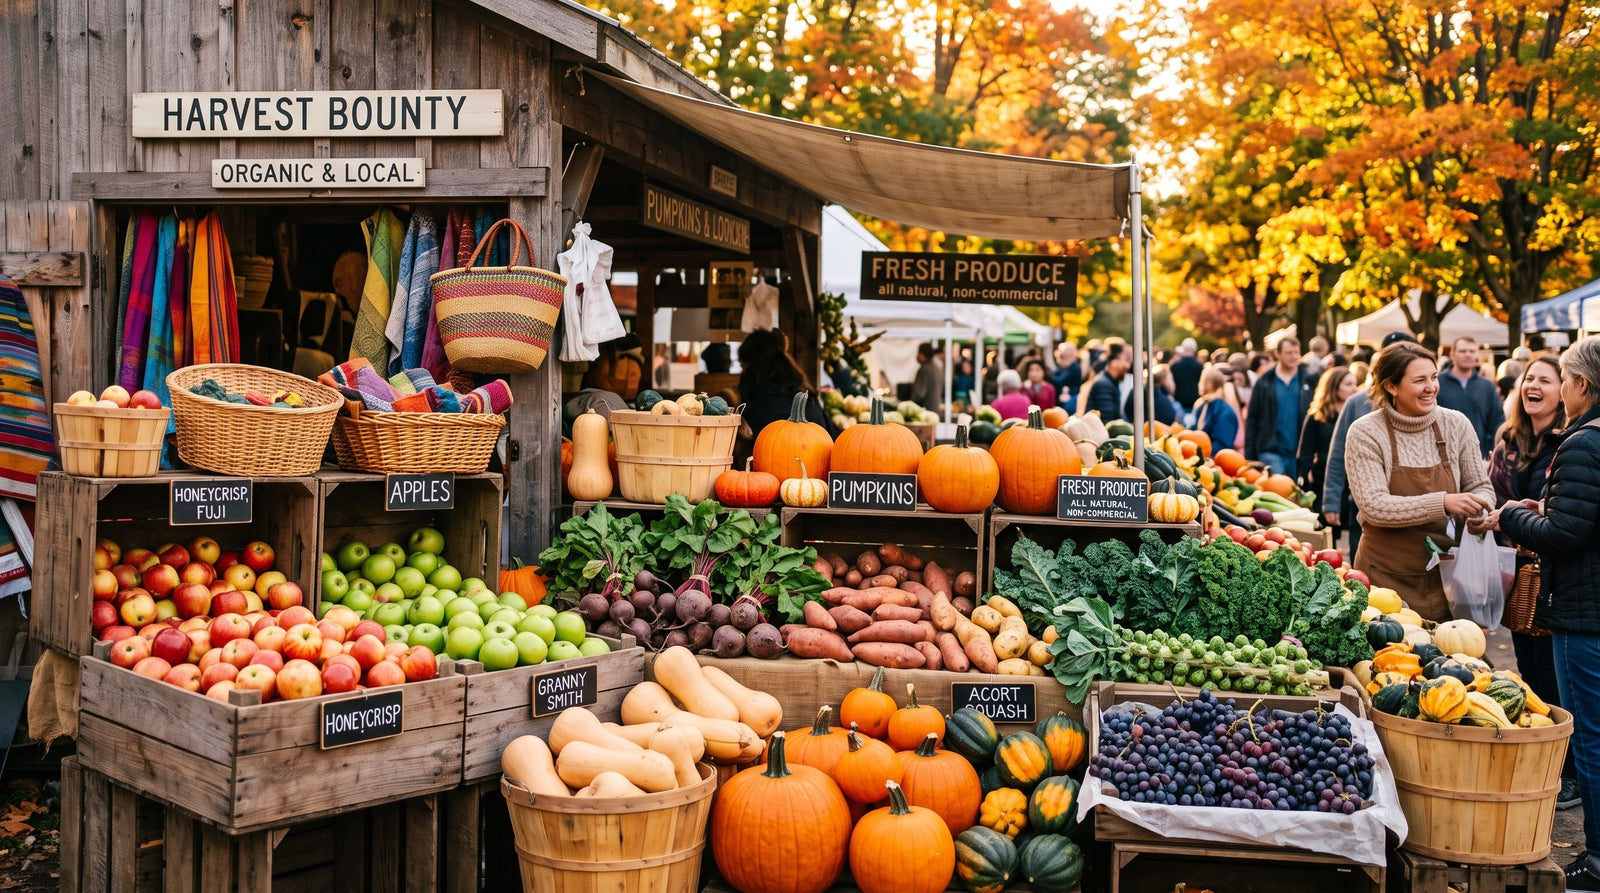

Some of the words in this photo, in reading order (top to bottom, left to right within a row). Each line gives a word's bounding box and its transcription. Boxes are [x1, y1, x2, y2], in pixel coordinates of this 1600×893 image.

[163, 97, 313, 131] HARVEST
[329, 96, 467, 130] BOUNTY
[220, 163, 313, 183] ORGANIC
[322, 164, 336, 182] &
[345, 163, 415, 182] LOCAL
[647, 189, 701, 235] PUMPKINS
[703, 210, 710, 238] &
[872, 257, 945, 281] FRESH
[954, 260, 1066, 285] PRODUCE
[878, 283, 894, 295] all
[899, 284, 947, 298] natural,
[952, 287, 1058, 301] non-commercial
[175, 486, 249, 503] HONEYCRISP,
[389, 480, 450, 503] APPLES
[832, 479, 914, 505] PUMPKINS
[1061, 479, 1095, 495] FRESH
[1100, 480, 1147, 497] PRODUCE
[197, 505, 226, 519] FUJI
[1066, 508, 1138, 519] NON-COMMERCIAL
[1070, 499, 1087, 507] ALL
[1090, 500, 1132, 510] NATURAL,
[538, 671, 587, 696] GRANNY
[547, 689, 583, 710] SMITH
[968, 686, 1020, 702] ACORT
